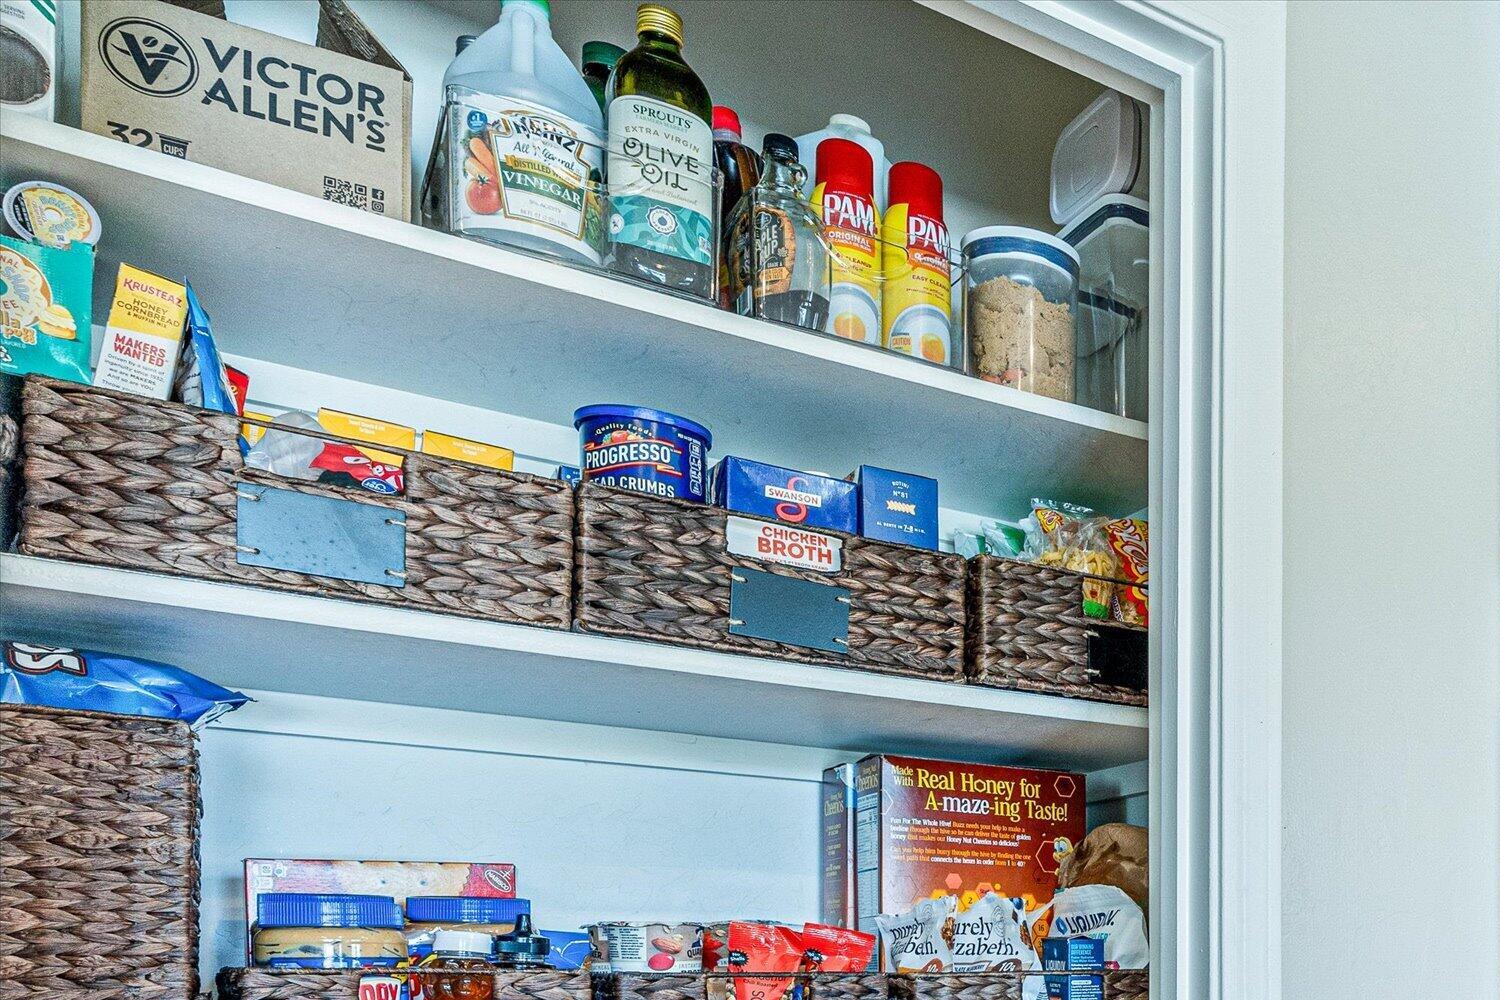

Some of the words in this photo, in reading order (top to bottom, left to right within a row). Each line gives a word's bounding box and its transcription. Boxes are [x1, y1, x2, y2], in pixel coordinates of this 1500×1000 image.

[201, 37, 385, 117] VICTOR
[201, 78, 386, 146] ALLEN'S
[633, 104, 692, 129] SPROUTS
[513, 141, 529, 154] All
[625, 125, 660, 137] EXTRA
[663, 132, 700, 154] VIRGIN
[163, 144, 184, 157] CUPS
[623, 137, 699, 175] OLIVE
[514, 158, 551, 175] DISTILLED
[641, 163, 688, 191] OIL
[502, 170, 582, 206] VINEGAR
[824, 194, 875, 237] PAM
[828, 230, 871, 247] ORIGINAL
[912, 274, 928, 283] EASY
[123, 278, 183, 307] KRUSTEAZ
[116, 300, 181, 328] CORNBREAD
[133, 298, 169, 316] HONEY
[132, 313, 155, 324] MUFFIN
[157, 320, 168, 329] MIX
[114, 343, 164, 368] WANTED
[115, 333, 167, 358] MAKERS
[107, 373, 119, 382] And
[130, 373, 157, 386] MAKERS
[596, 422, 625, 436] Quality
[627, 423, 653, 437] Foods
[586, 443, 671, 469] PROGRESSO
[590, 476, 615, 487] EAD
[620, 476, 675, 498] CRUMBS
[768, 488, 819, 505] SWANSON
[761, 525, 828, 546] CHICKEN
[757, 536, 832, 565] BROTH
[891, 765, 914, 776] Made
[893, 776, 914, 787] With
[916, 768, 955, 790] Real
[960, 773, 1015, 801] Honey
[1019, 779, 1042, 799] for
[924, 791, 1021, 822] A-maze-ing
[1024, 799, 1068, 822] Taste!
[946, 836, 963, 844] Honey
[488, 870, 511, 891] NABISCO
[967, 896, 973, 904] 2
[955, 917, 993, 937] urely
